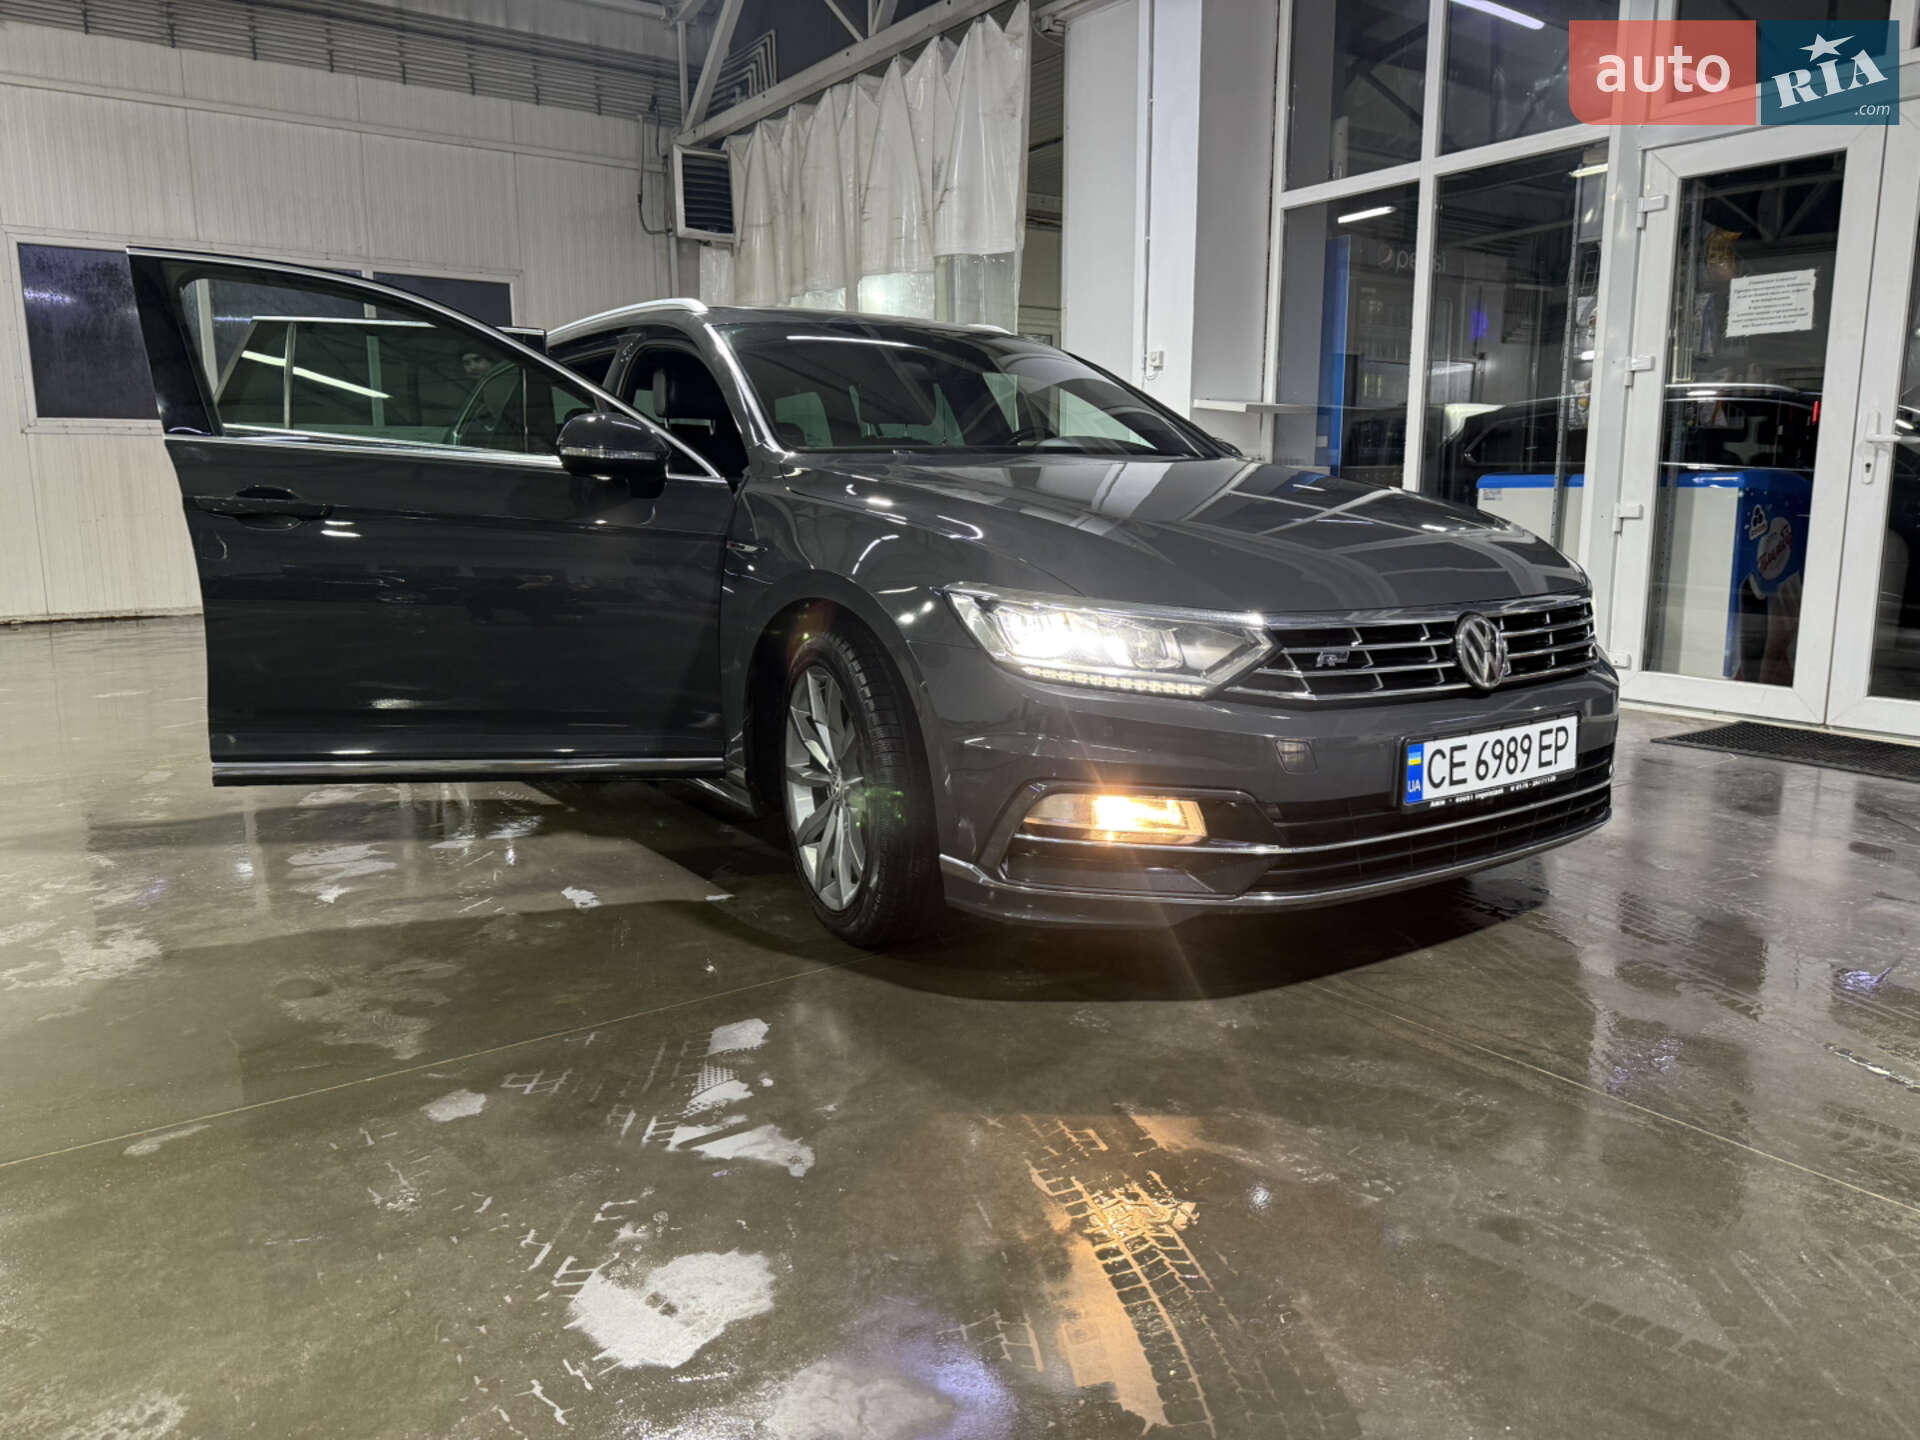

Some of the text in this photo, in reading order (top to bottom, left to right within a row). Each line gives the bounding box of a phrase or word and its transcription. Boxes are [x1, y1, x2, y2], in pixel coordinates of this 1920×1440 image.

[1395, 249, 1446, 274] pesi
[1427, 725, 1569, 790] CE 6989 EP
[1408, 780, 1421, 792] UA
